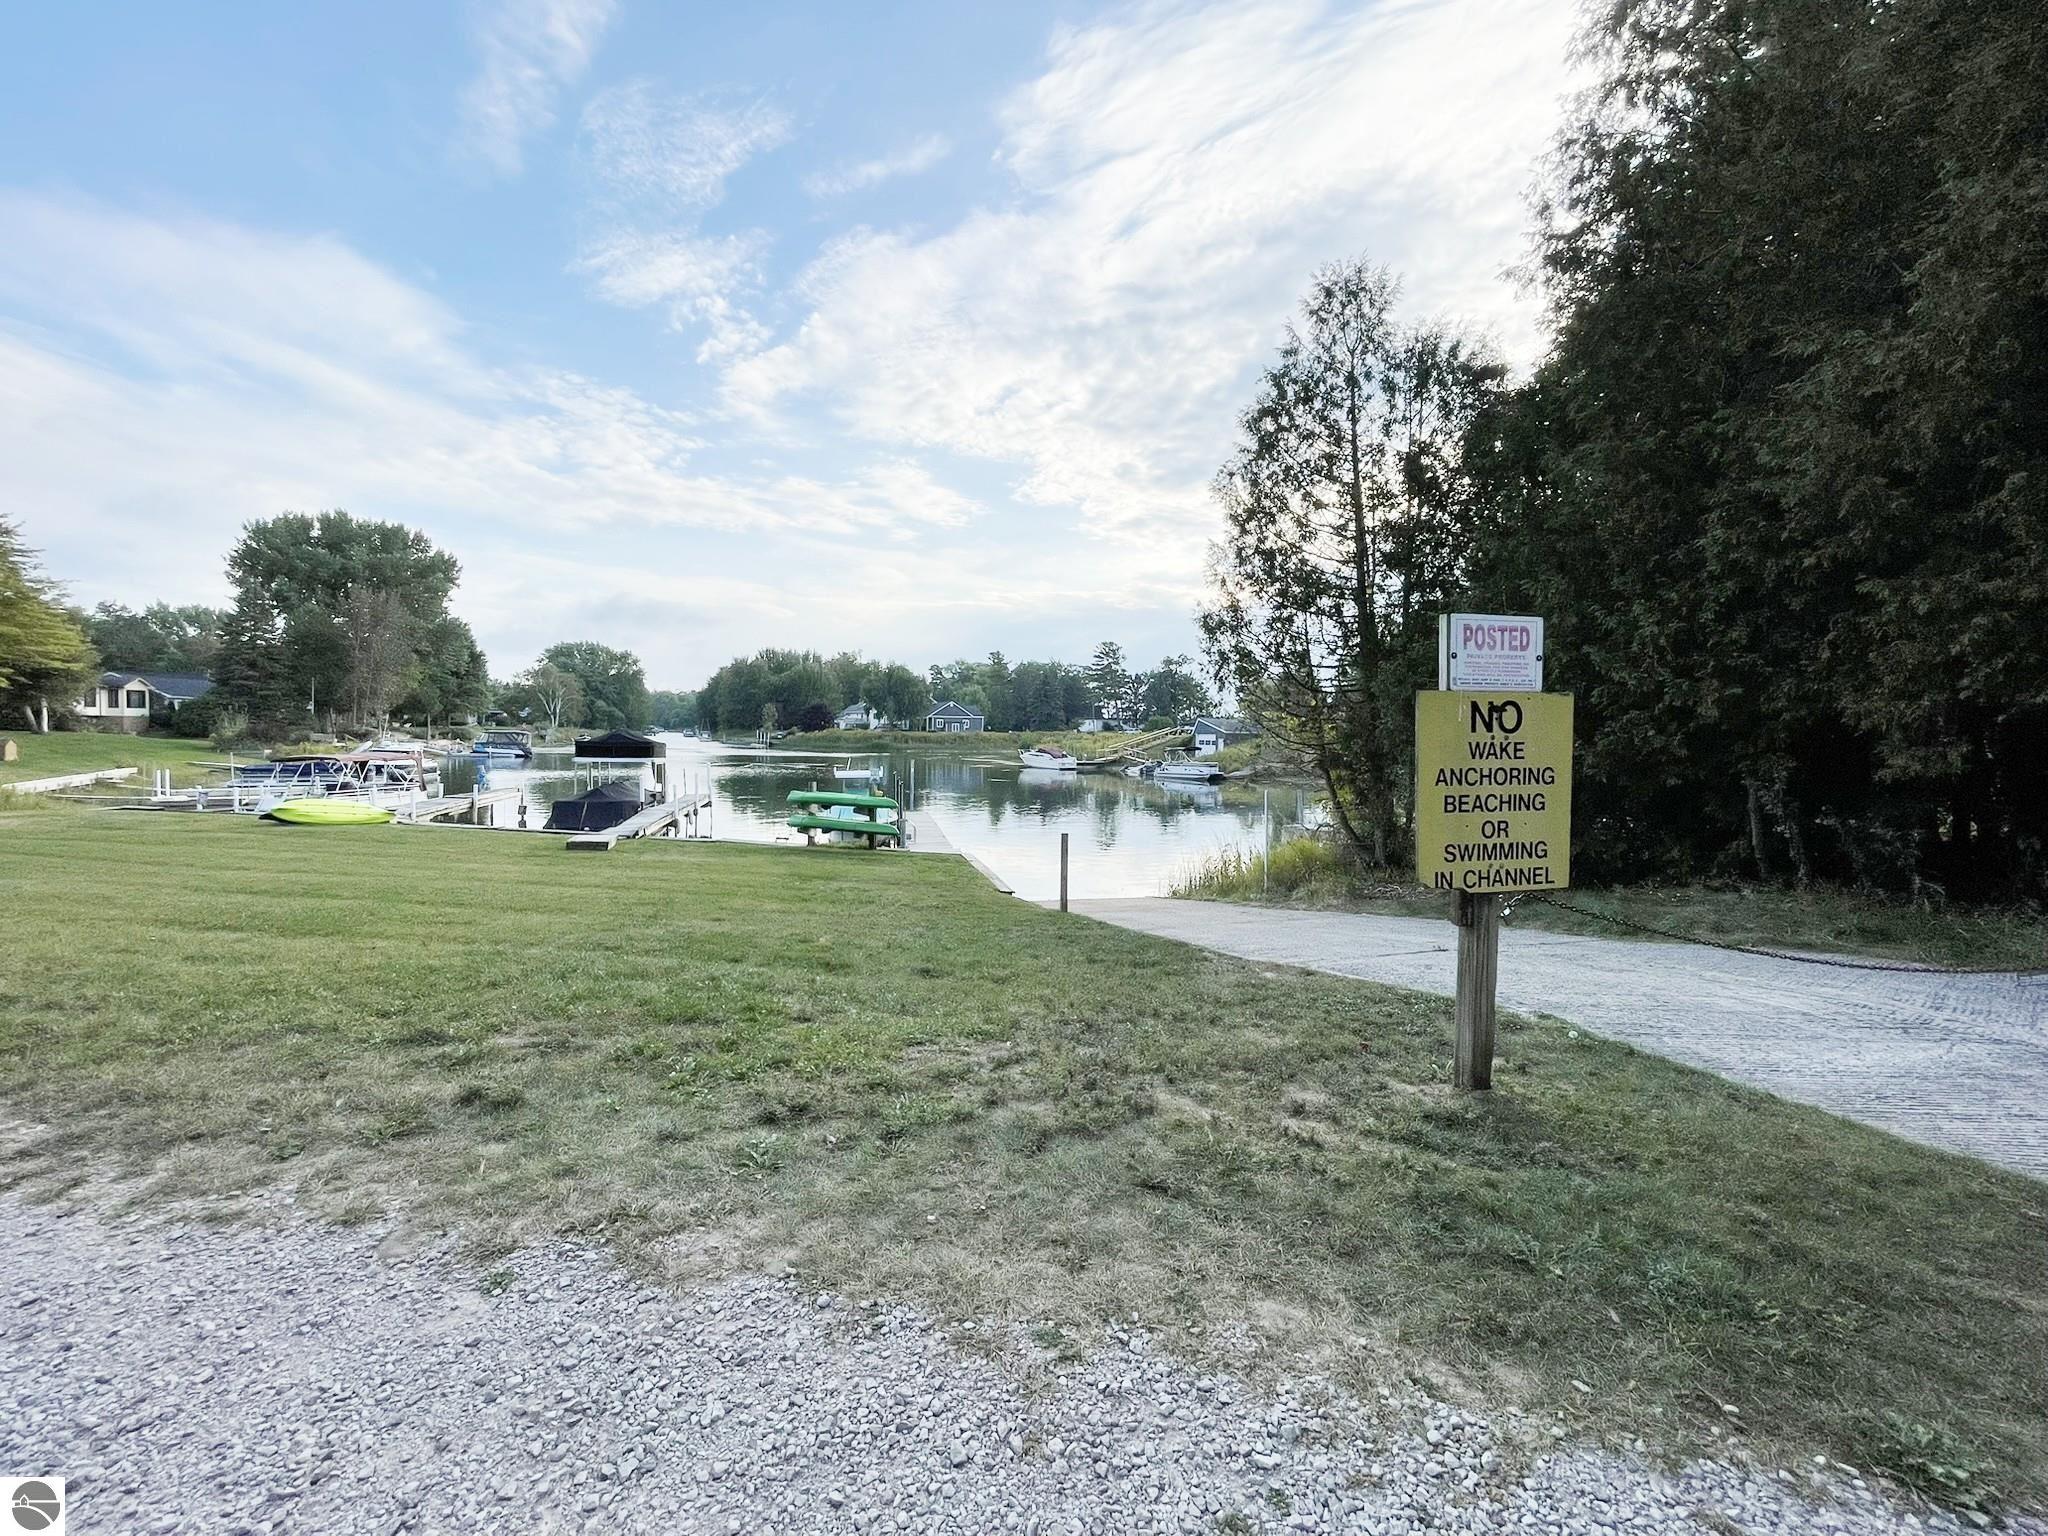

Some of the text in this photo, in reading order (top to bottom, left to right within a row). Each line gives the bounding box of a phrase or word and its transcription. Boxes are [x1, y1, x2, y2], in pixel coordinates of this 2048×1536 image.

[1463, 623, 1530, 651] POSTED
[1470, 700, 1523, 734] NO
[1468, 741, 1525, 760] WAKE
[1435, 767, 1555, 787] ANCHORING
[1443, 793, 1546, 813] BEACHING
[1481, 820, 1509, 839] OR
[1444, 841, 1548, 863] SWIMMING
[1434, 867, 1555, 889] IN CHANNEL
